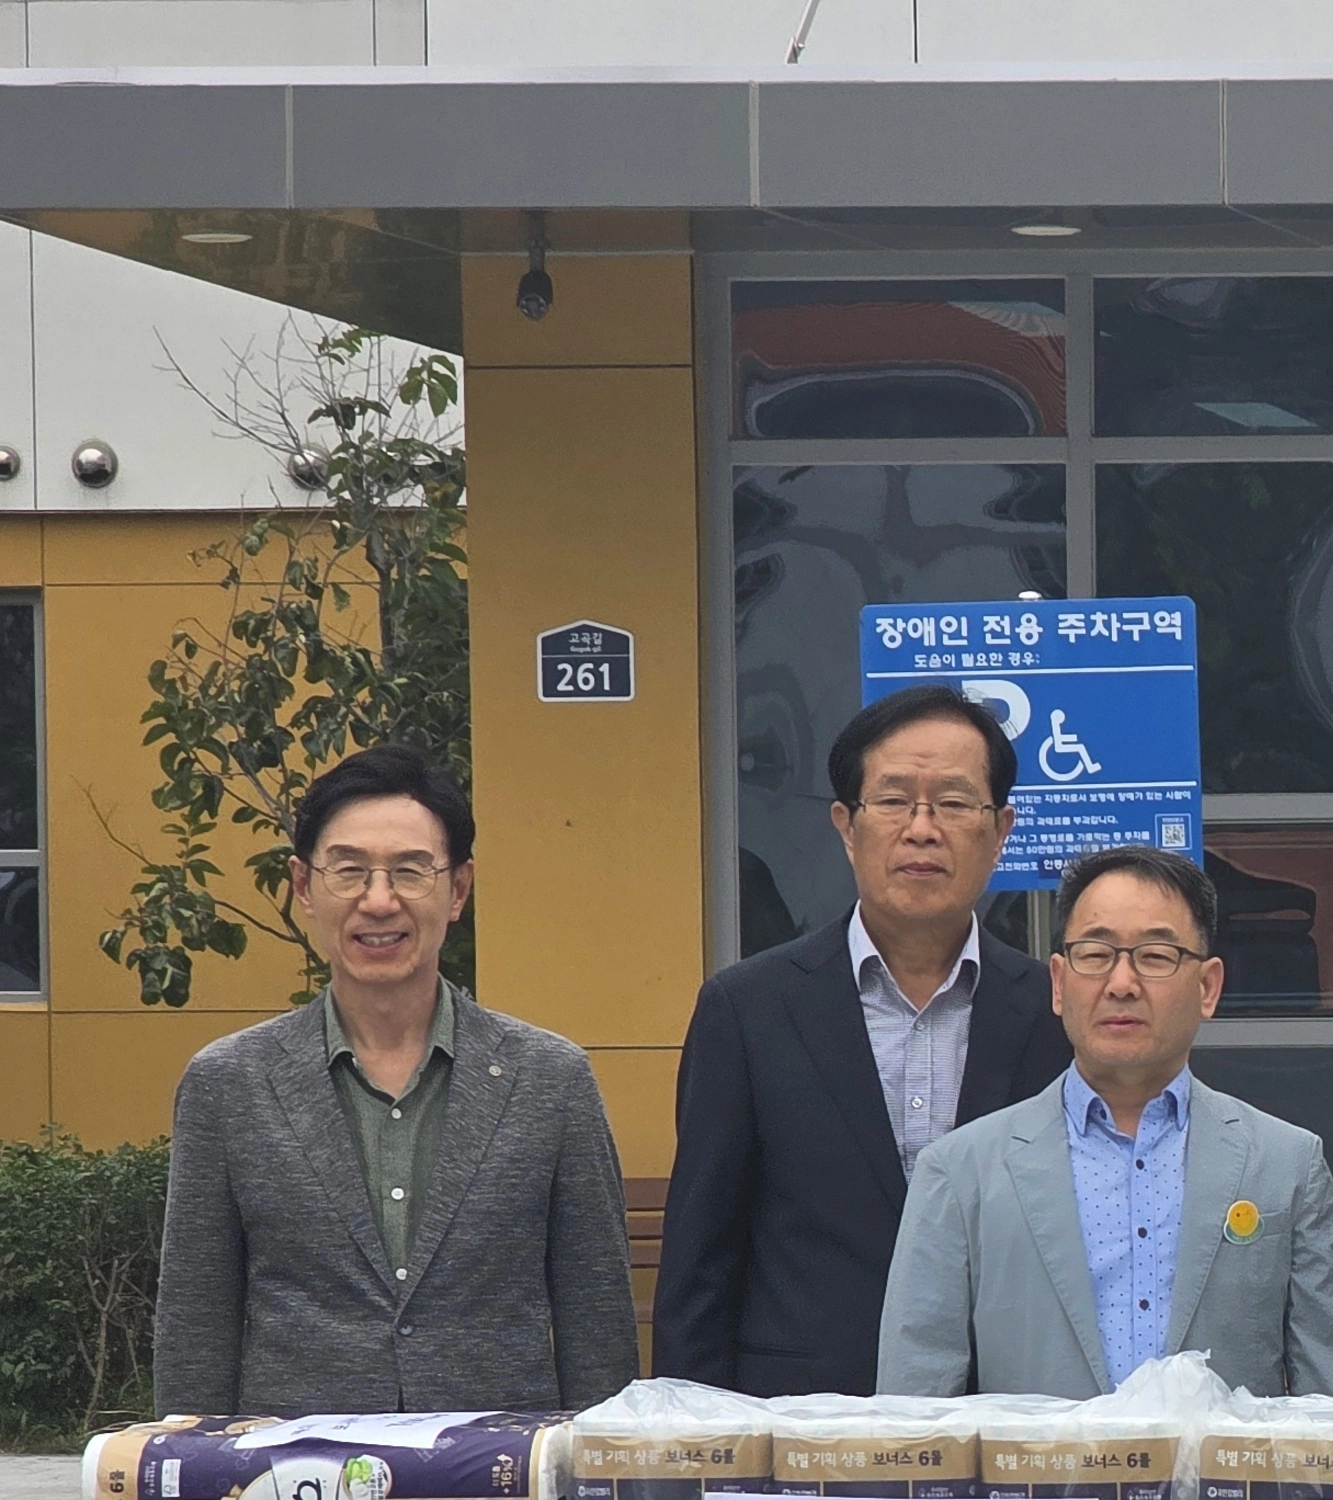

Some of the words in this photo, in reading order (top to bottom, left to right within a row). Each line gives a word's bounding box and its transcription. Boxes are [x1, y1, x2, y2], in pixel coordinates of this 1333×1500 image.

[875, 616, 968, 649] 장애인
[983, 613, 1043, 645] 전용
[1057, 611, 1182, 643] 주차구역
[914, 653, 956, 669] 도움이
[962, 652, 1003, 668] 필요한
[1008, 651, 1041, 667] 경우:
[556, 662, 611, 691] 261
[872, 1450, 914, 1468] 보너스
[918, 1450, 943, 1467] 6롤
